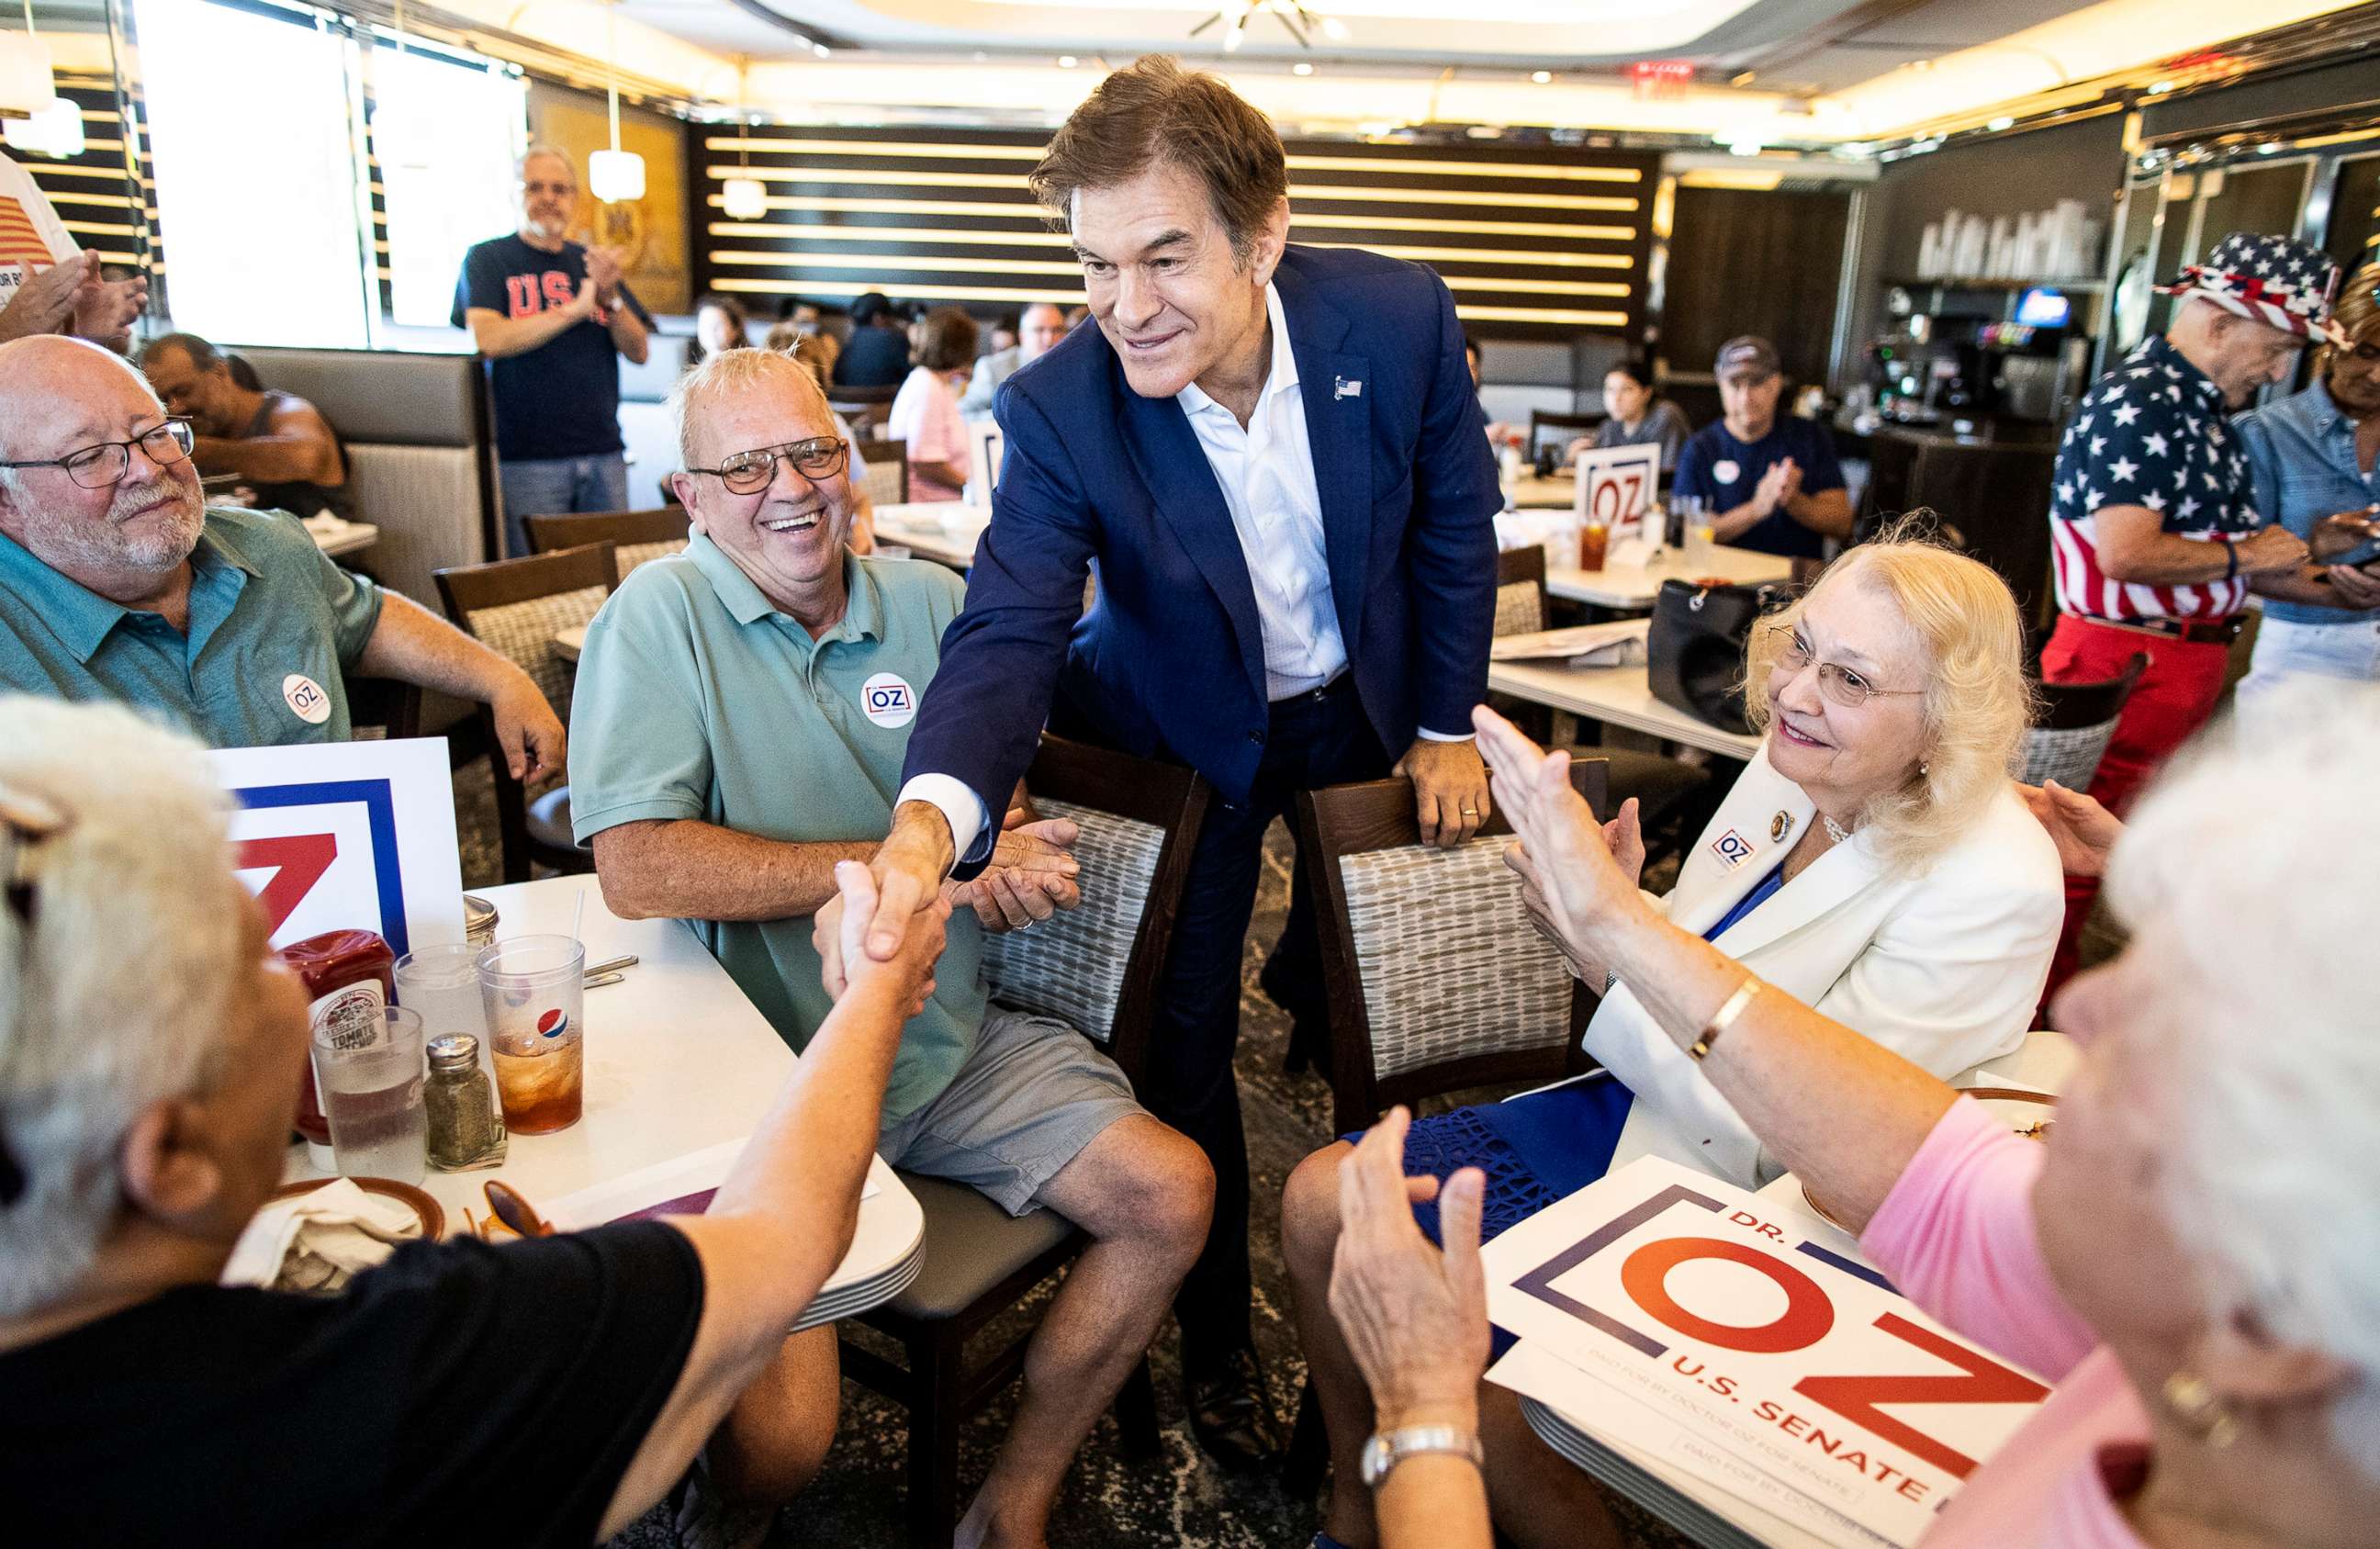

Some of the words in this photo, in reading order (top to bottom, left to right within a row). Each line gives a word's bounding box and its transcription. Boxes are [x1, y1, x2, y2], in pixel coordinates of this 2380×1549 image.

[1594, 476, 1642, 526] OZ
[295, 686, 318, 708] OZ
[871, 690, 905, 707] OZ
[1721, 837, 1749, 863] OZ
[1728, 1210, 1785, 1243] DR.
[1621, 1236, 2053, 1484] OZ
[1672, 1355, 1740, 1403] U.S.
[1752, 1400, 1930, 1503] SENATE
